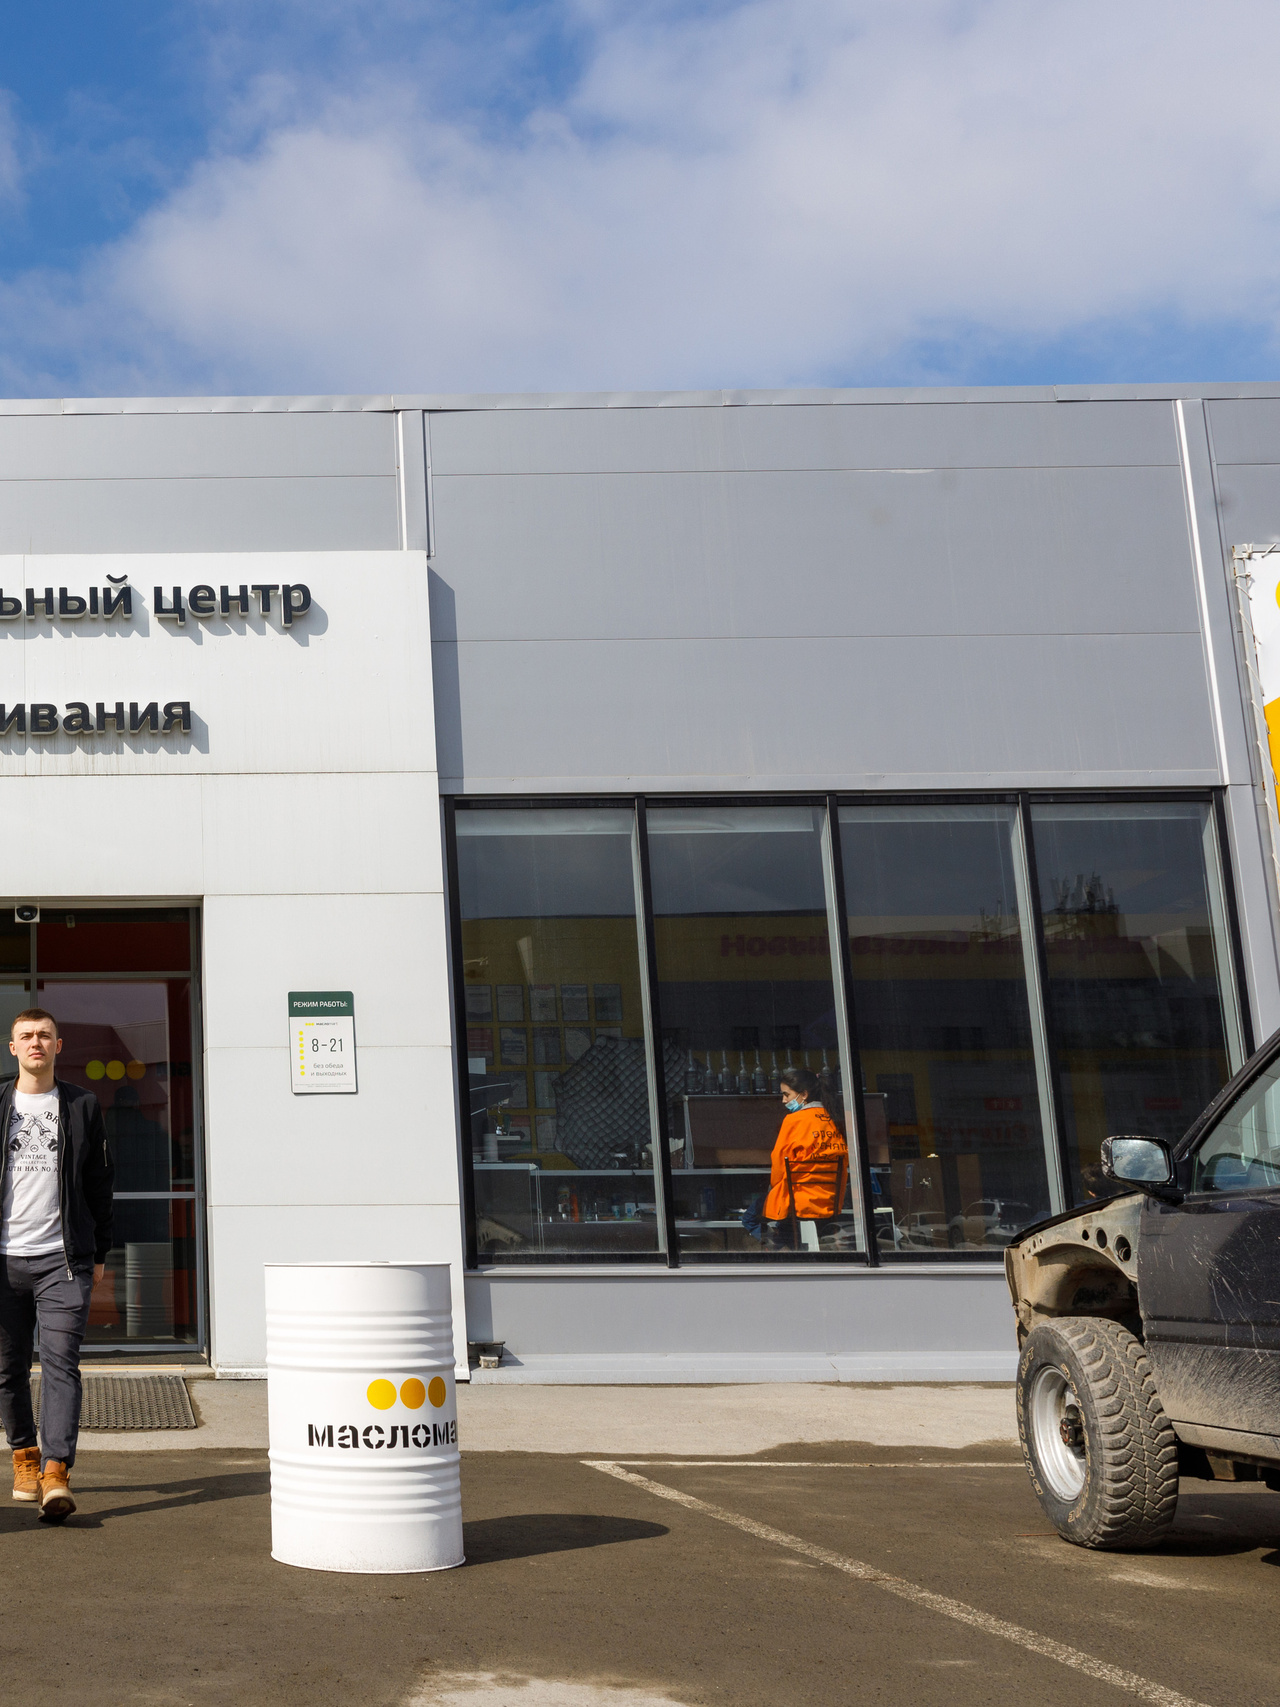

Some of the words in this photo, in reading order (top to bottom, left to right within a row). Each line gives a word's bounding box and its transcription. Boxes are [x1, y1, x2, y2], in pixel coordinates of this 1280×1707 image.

[153, 580, 312, 627] центр
[319, 1000, 348, 1008] РАБОТЫ:
[307, 1420, 458, 1450] маслома
